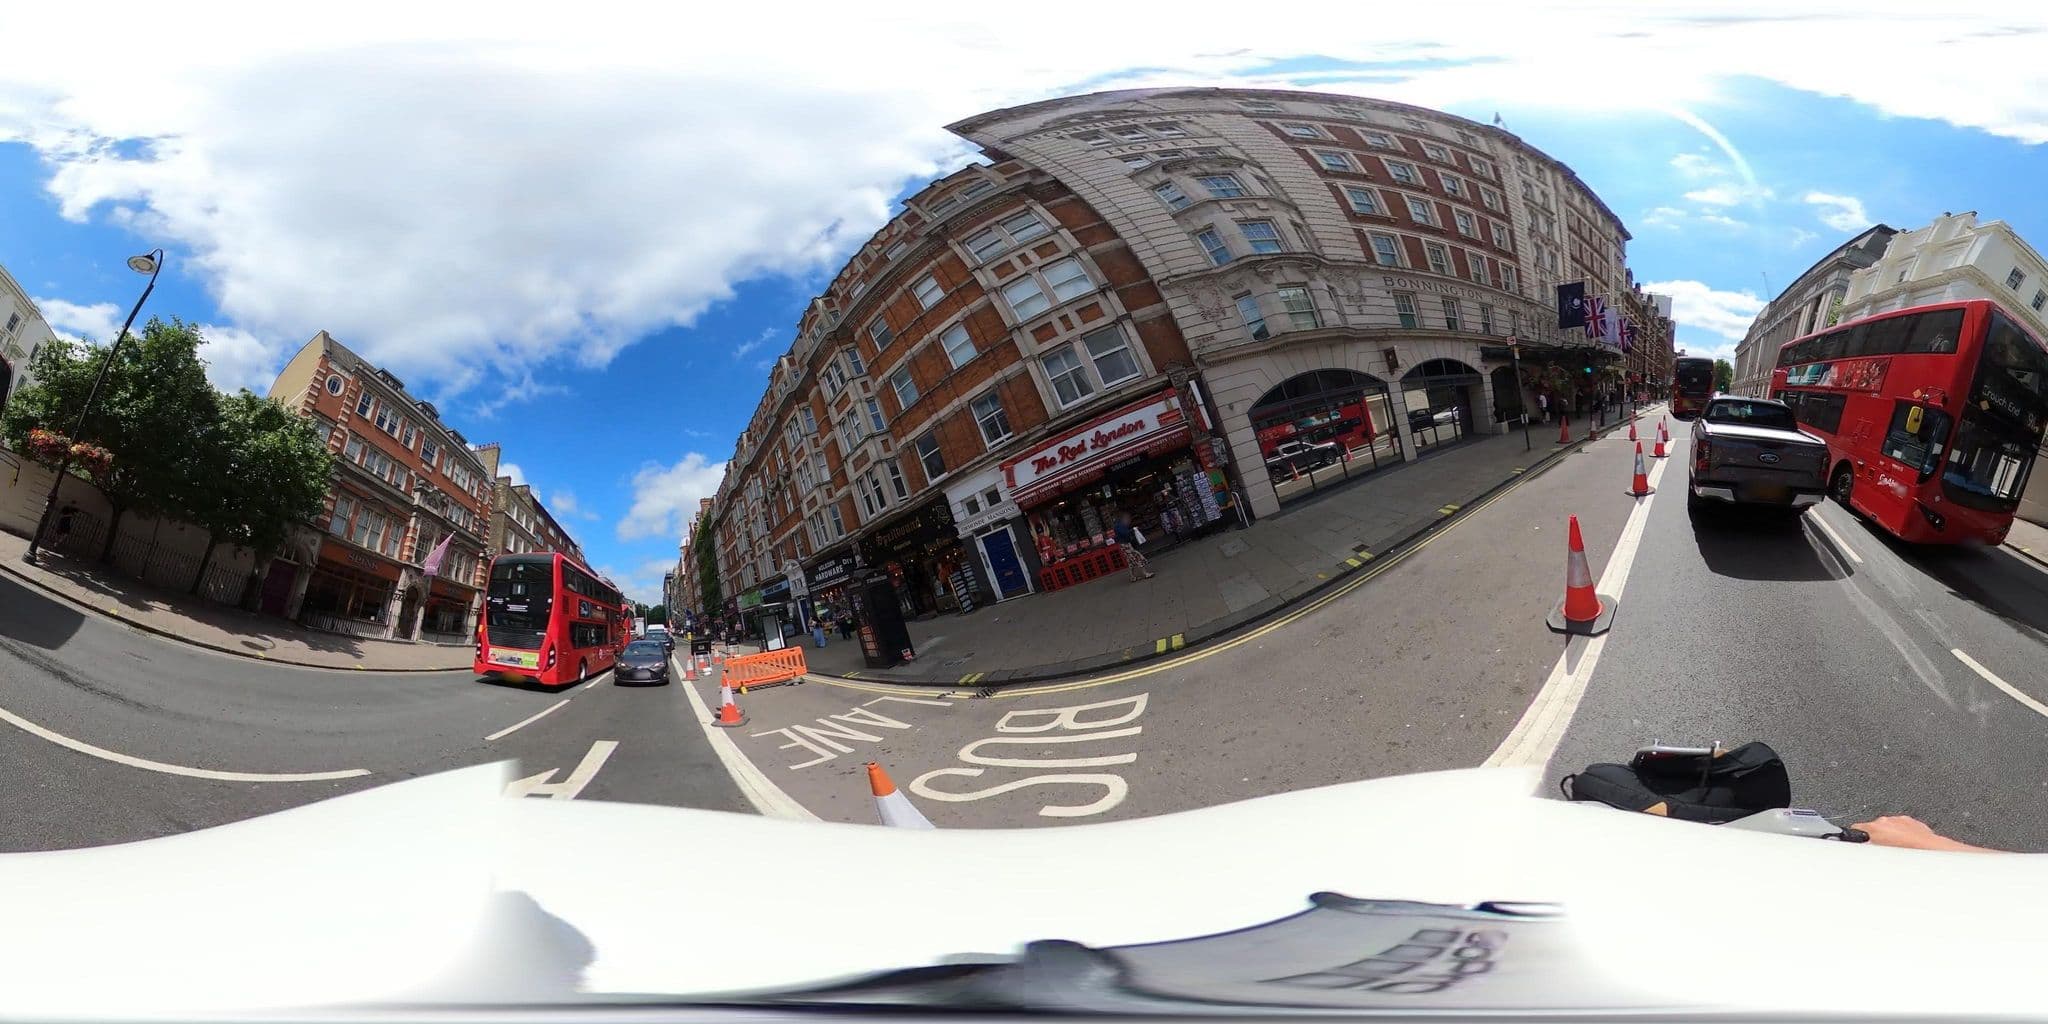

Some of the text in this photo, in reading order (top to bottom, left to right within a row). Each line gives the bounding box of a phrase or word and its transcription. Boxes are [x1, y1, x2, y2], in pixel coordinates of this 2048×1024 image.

[1382, 275, 1483, 300] BONNINGTON
[1982, 384, 2020, 417] Crouch End
[1031, 418, 1146, 475] The Red London
[815, 564, 844, 582] HARDWARE
[751, 695, 954, 771] LANE
[909, 692, 1149, 818] BUS
